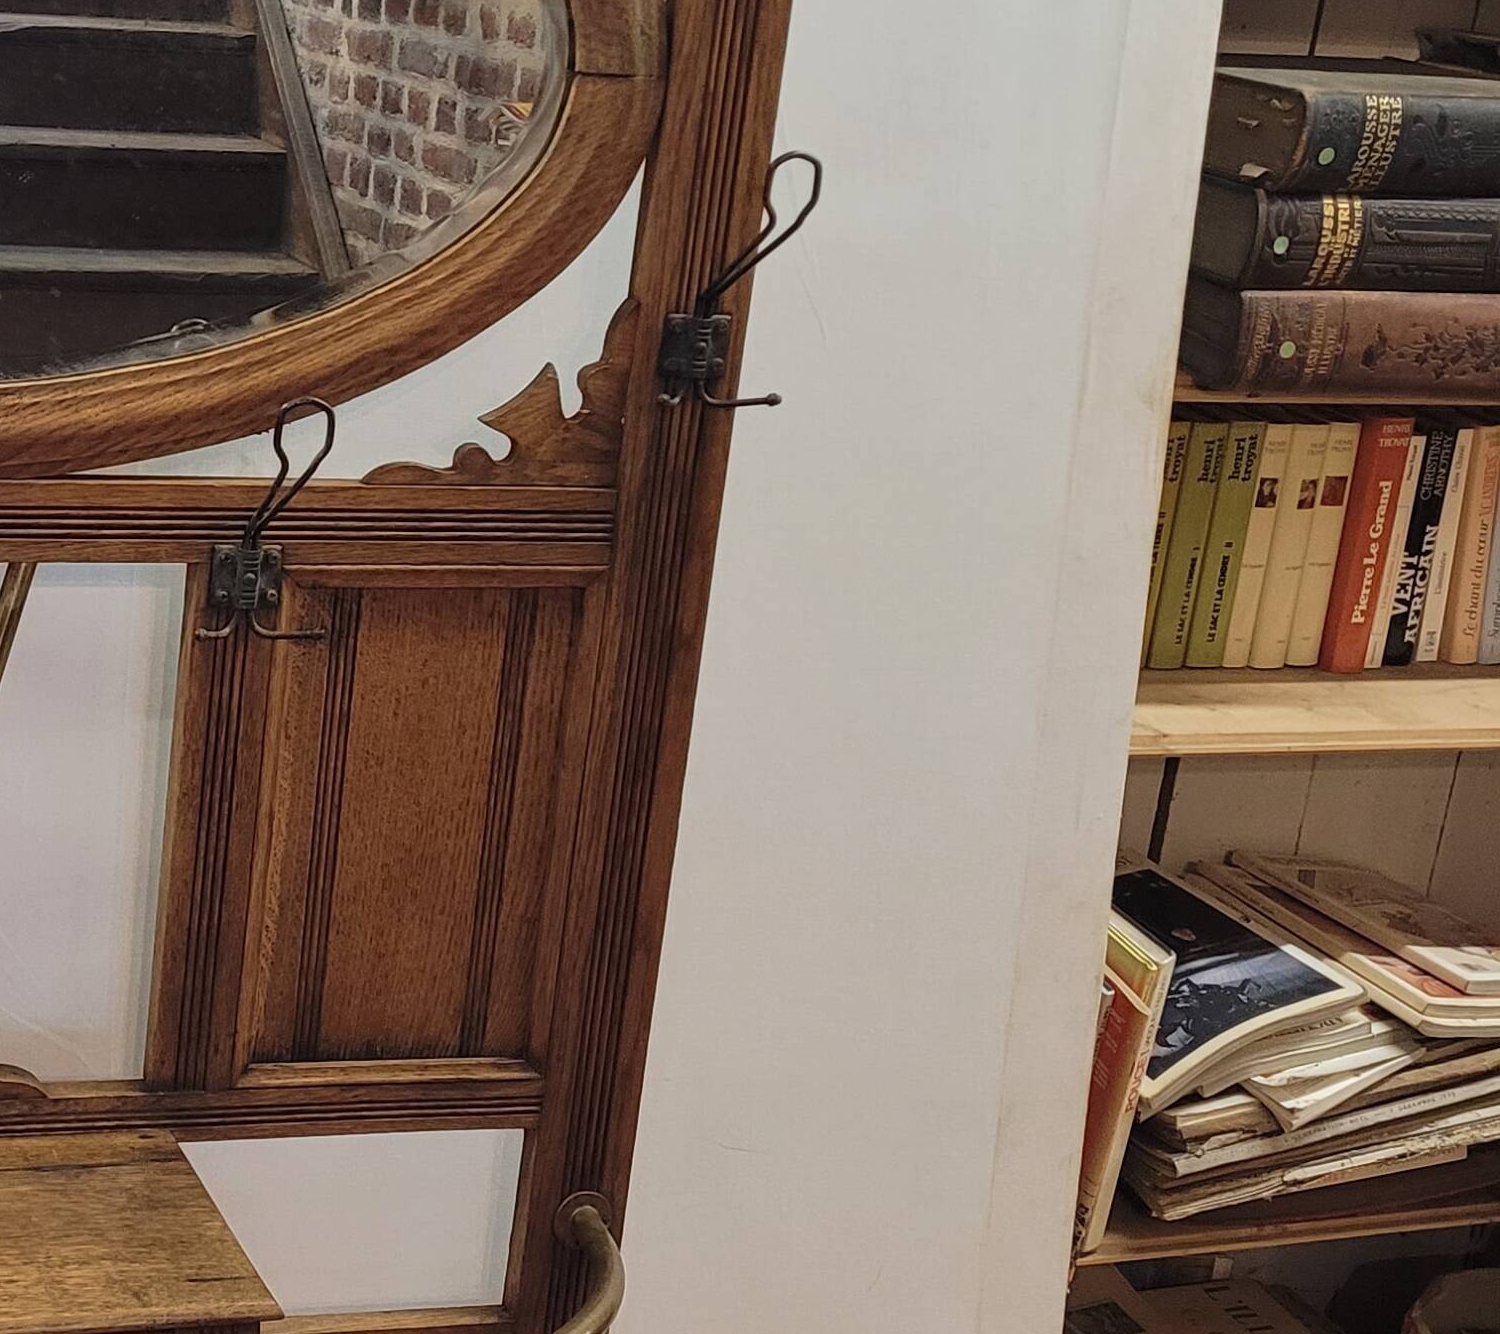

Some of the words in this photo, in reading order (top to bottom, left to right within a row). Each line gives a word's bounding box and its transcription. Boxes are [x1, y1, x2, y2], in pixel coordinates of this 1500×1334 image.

[1383, 424, 1411, 434] HENRI
[1169, 434, 1187, 483] troyat
[1197, 439, 1216, 483] henri
[1210, 436, 1225, 484] troyat
[1228, 437, 1247, 481] henri
[1241, 434, 1258, 483] troyat
[1420, 431, 1442, 500] CHRISTINE
[1433, 434, 1453, 497] ARNOTHY
[1369, 480, 1393, 540] Grand
[1217, 554, 1231, 587] CENDRE
[1363, 542, 1380, 566] Le
[1213, 598, 1221, 612] ET
[1215, 584, 1224, 601] LA
[1351, 567, 1375, 624] Pierre
[1391, 551, 1419, 617] VENT
[1403, 524, 1440, 644] AFRICAIN
[1464, 581, 1481, 621] chant
[1207, 630, 1215, 643] LE
[1209, 611, 1218, 631] SAC
